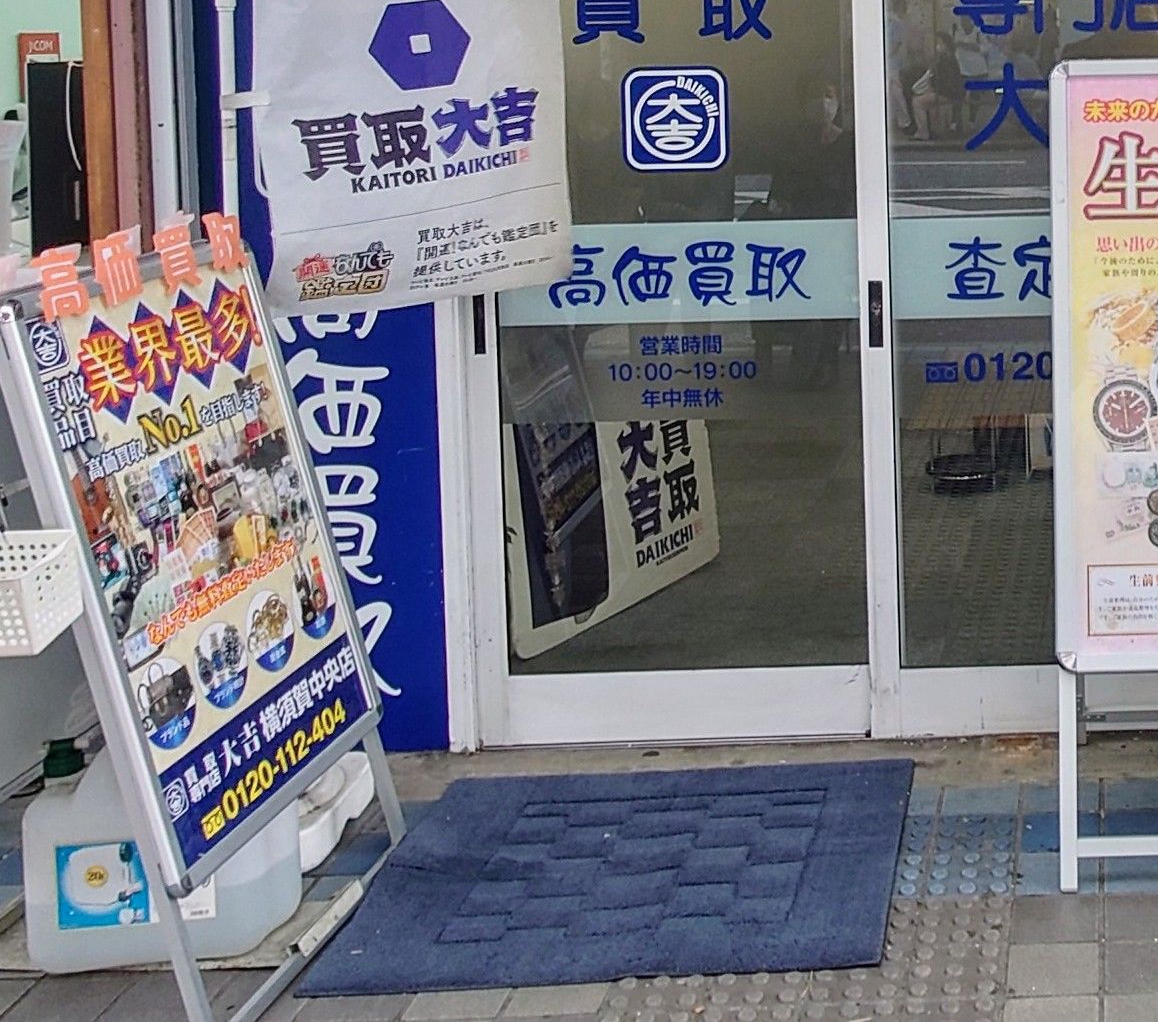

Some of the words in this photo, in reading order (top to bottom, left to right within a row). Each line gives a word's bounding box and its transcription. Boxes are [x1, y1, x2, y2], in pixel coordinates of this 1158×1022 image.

[676, 76, 720, 117] DAIKICHI
[291, 87, 539, 181] 買取大吉
[351, 167, 437, 194] KAITORI
[443, 149, 518, 180] DAIKICHI
[548, 241, 812, 309] 高価買取
[639, 334, 723, 355] 営業時間
[641, 388, 724, 409] 年中無休
[636, 523, 694, 568] DAIKICHI
[222, 698, 347, 820] 0120-112-404
